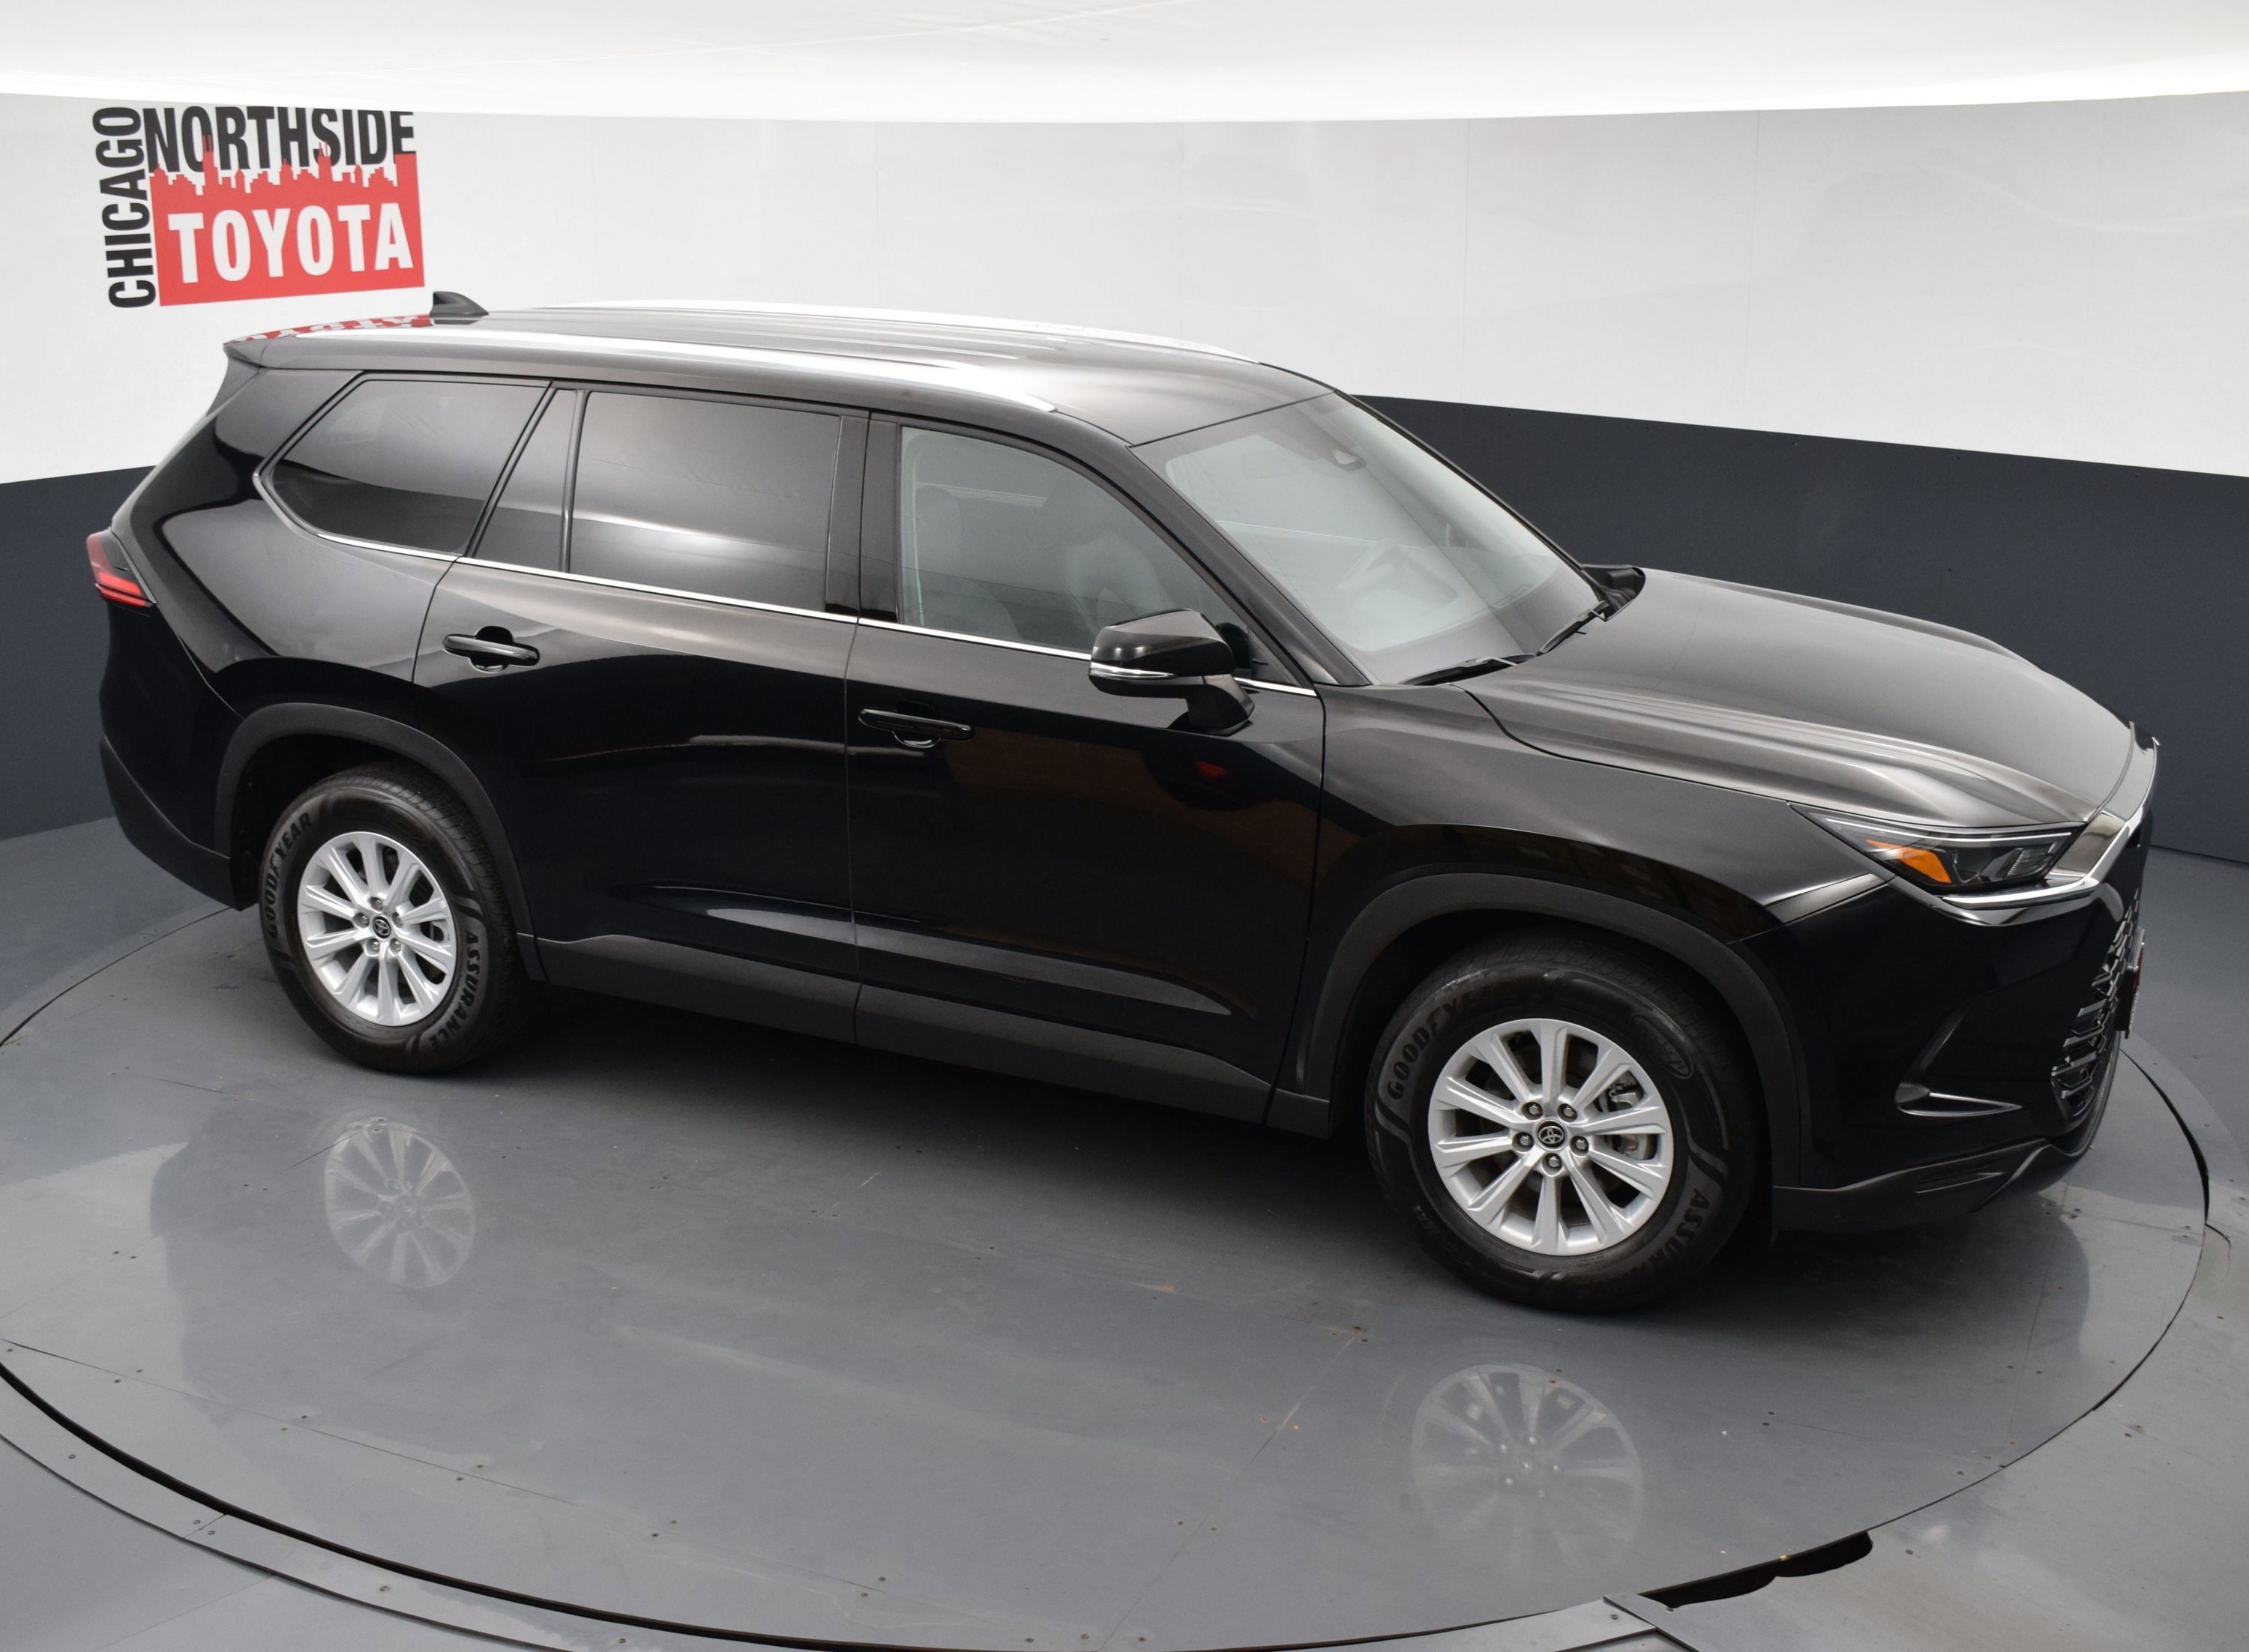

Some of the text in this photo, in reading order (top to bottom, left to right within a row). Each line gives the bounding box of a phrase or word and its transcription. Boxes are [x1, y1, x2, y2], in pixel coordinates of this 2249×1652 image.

[142, 105, 416, 173] NORTHSIDE
[91, 106, 157, 309] CHICAGO
[167, 202, 415, 283] TOYOTA
[264, 812, 313, 939] GOODYEAR
[428, 929, 481, 1048] ASSURANCE
